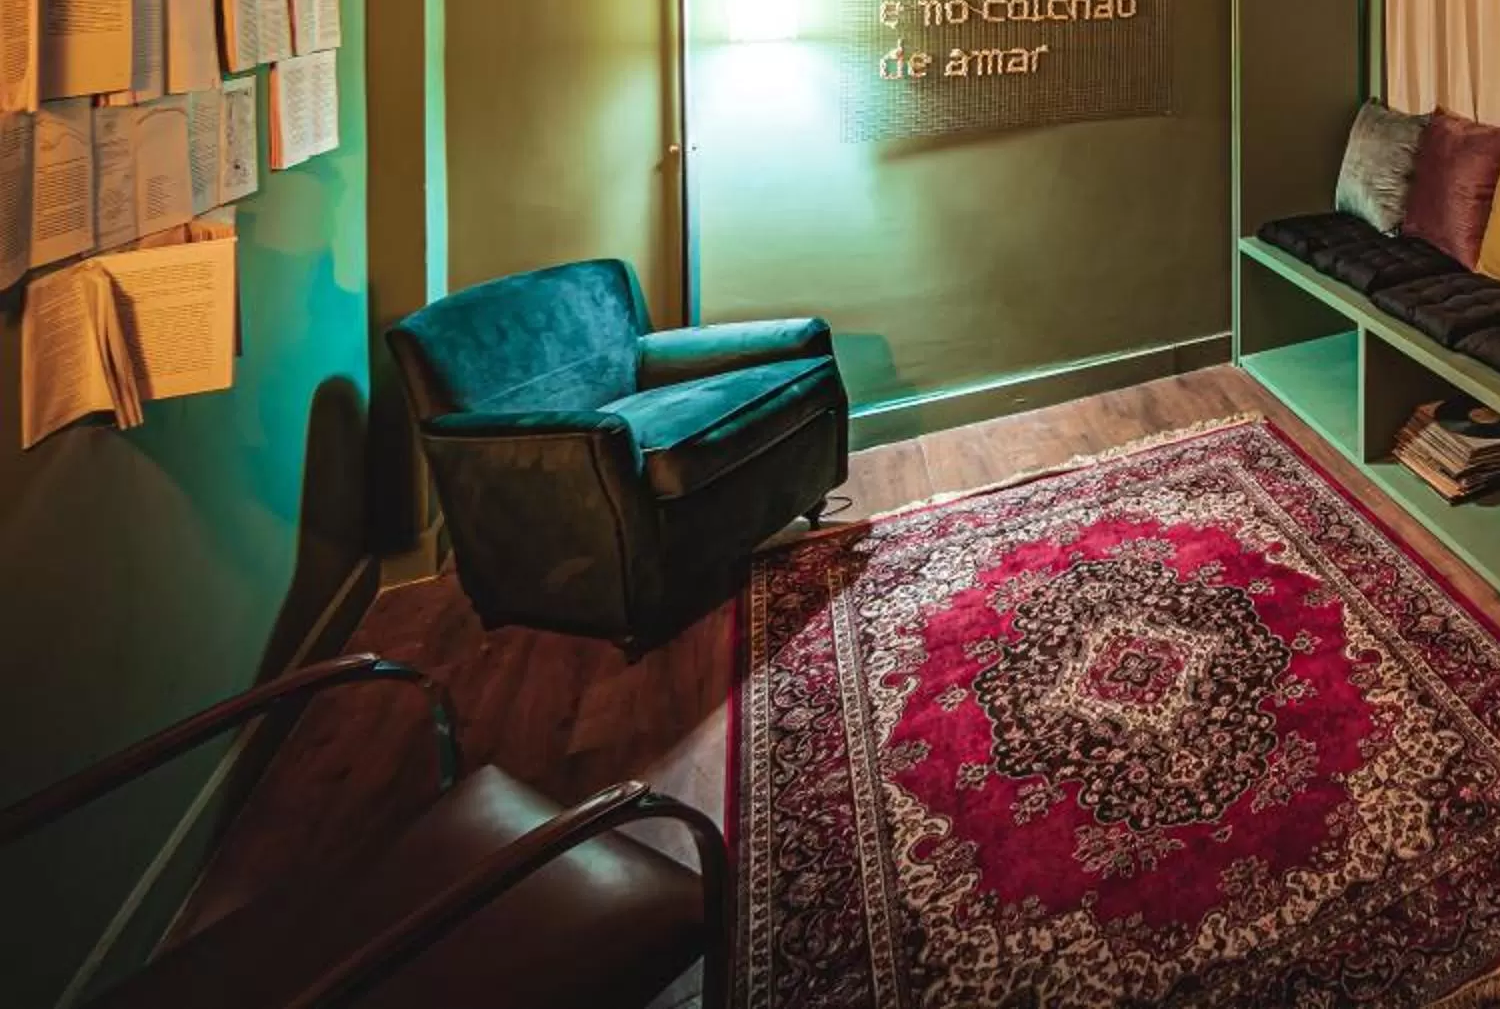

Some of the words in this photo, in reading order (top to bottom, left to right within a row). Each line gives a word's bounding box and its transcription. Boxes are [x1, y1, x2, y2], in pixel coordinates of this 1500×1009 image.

[880, 0, 904, 29] e
[880, 38, 932, 80] de
[944, 44, 1049, 78] amar
